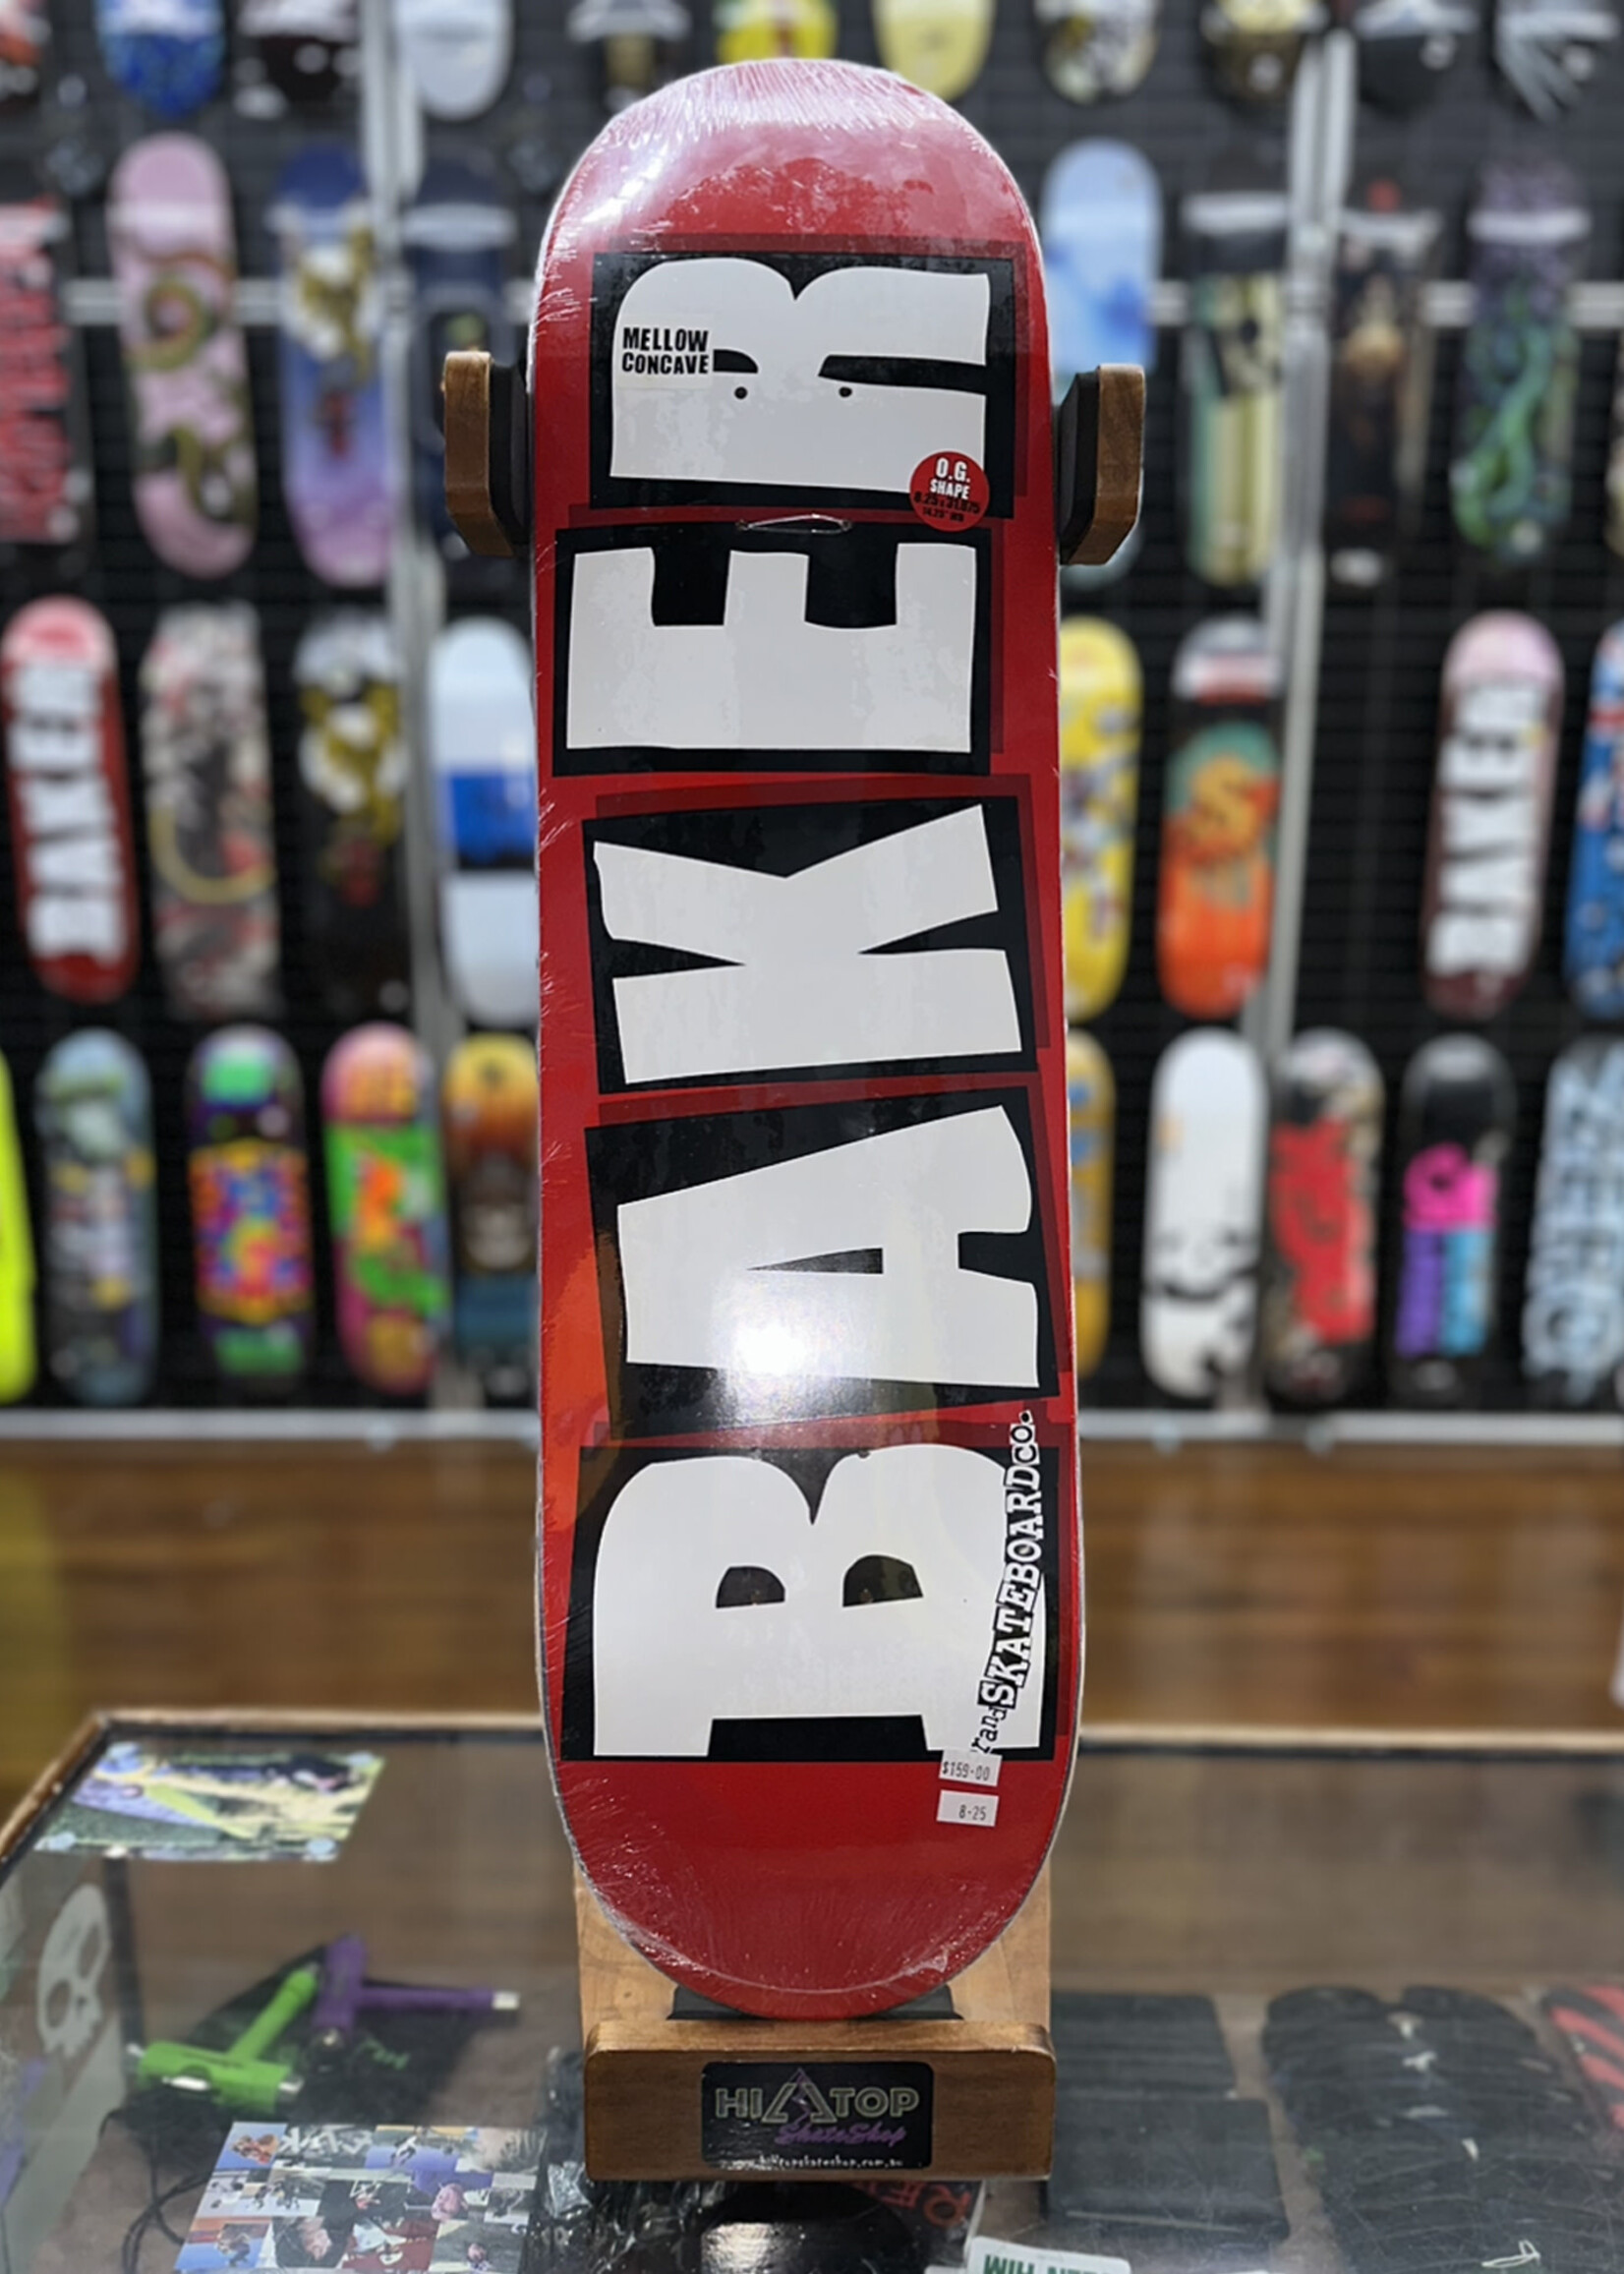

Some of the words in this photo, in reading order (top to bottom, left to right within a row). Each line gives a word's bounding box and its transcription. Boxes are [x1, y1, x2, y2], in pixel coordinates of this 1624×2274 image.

[623, 326, 709, 353] MELLOW
[622, 351, 709, 375] CONCAVE
[935, 457, 971, 483] O.G.
[929, 478, 970, 500] SHAPE
[566, 258, 1044, 1760] BAKER
